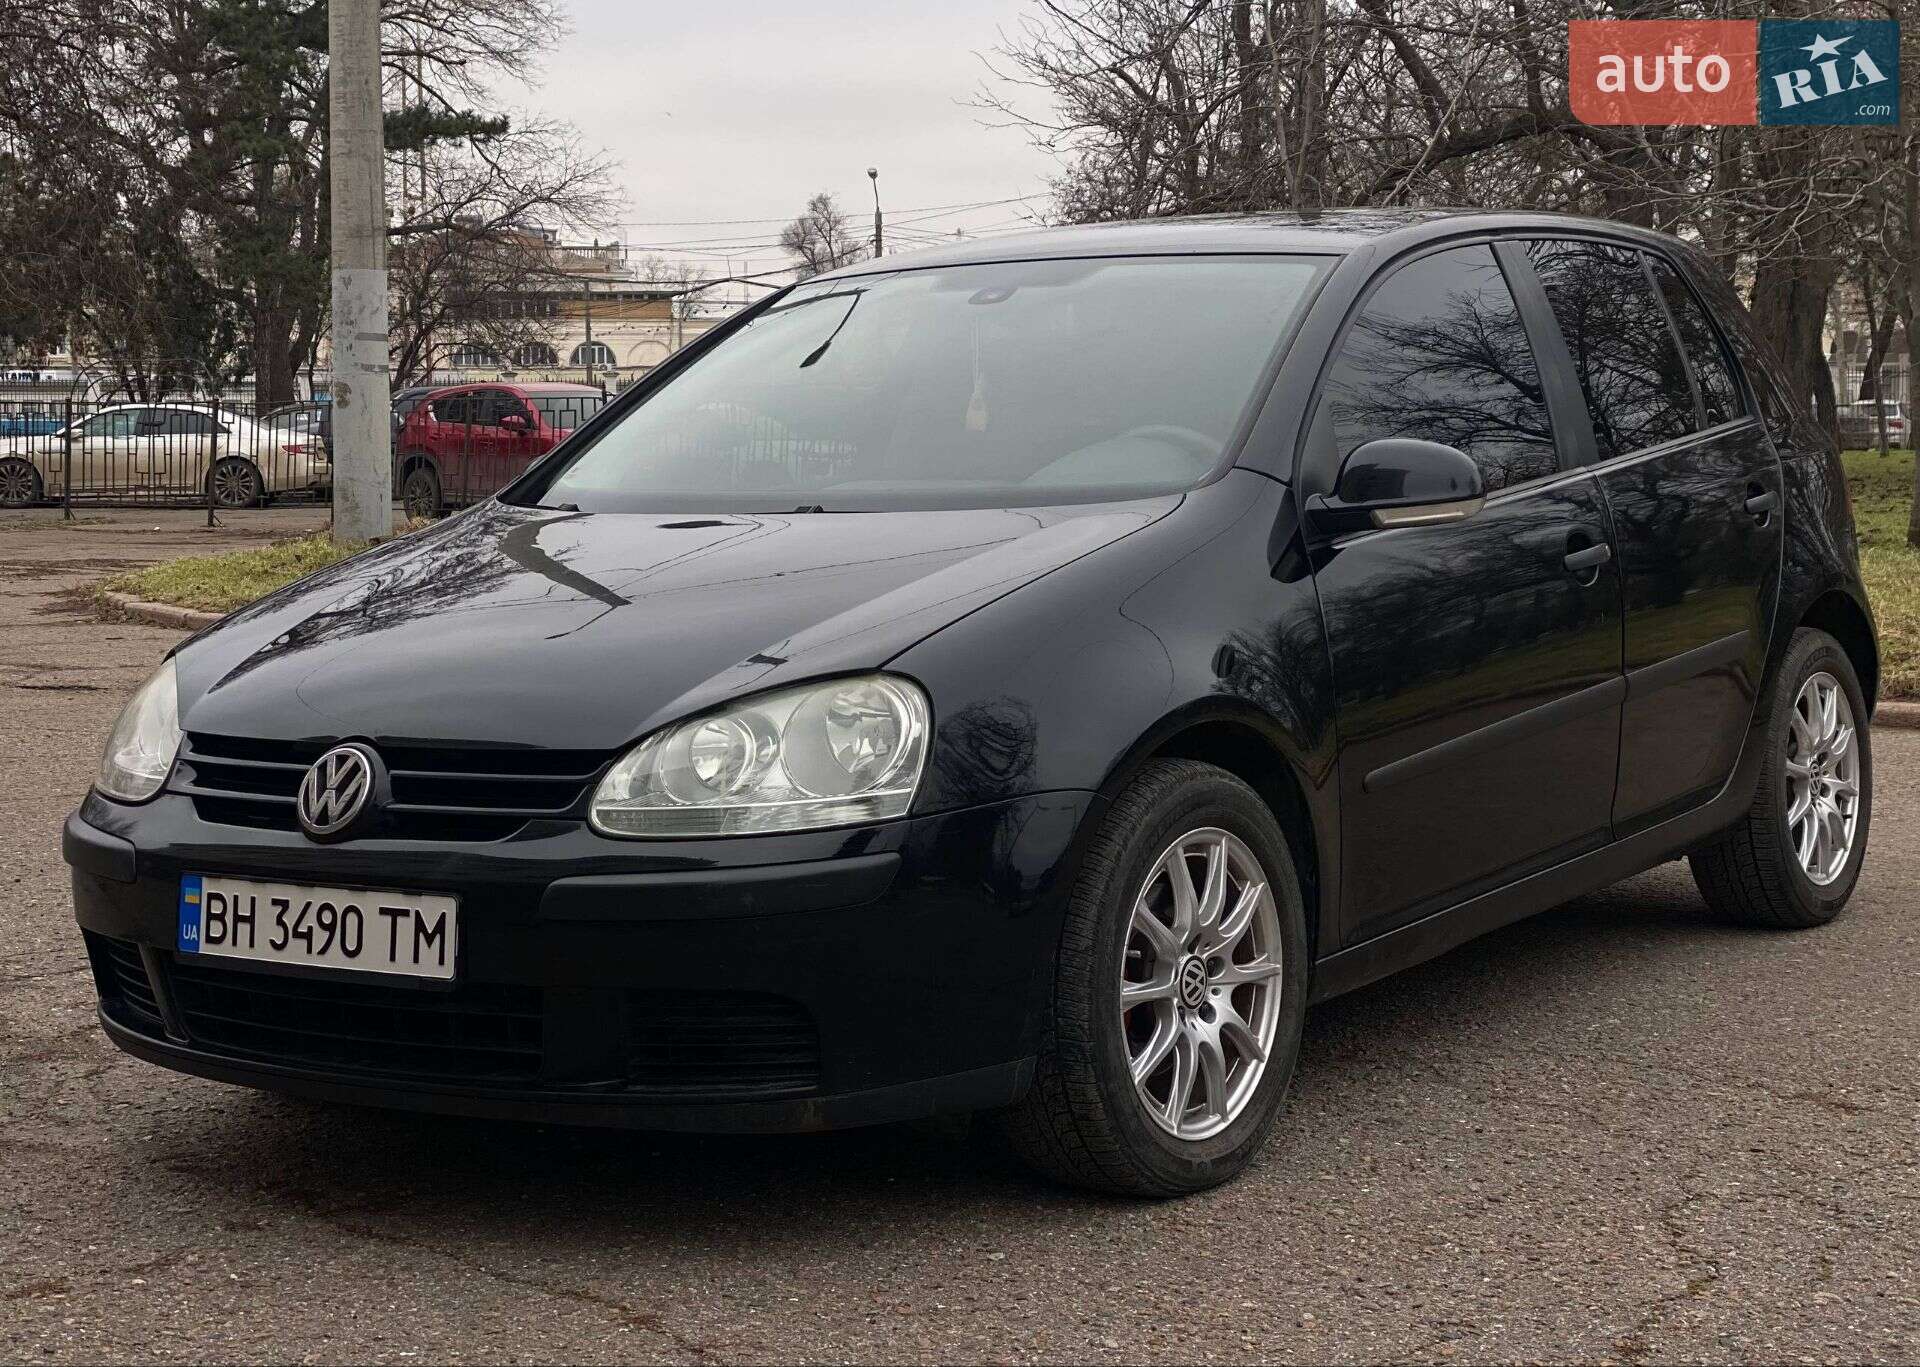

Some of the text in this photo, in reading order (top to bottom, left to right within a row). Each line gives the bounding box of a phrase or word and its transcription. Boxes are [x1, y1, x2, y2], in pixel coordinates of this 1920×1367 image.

[182, 923, 198, 941] UA
[204, 891, 447, 966] BH 3490 TM
